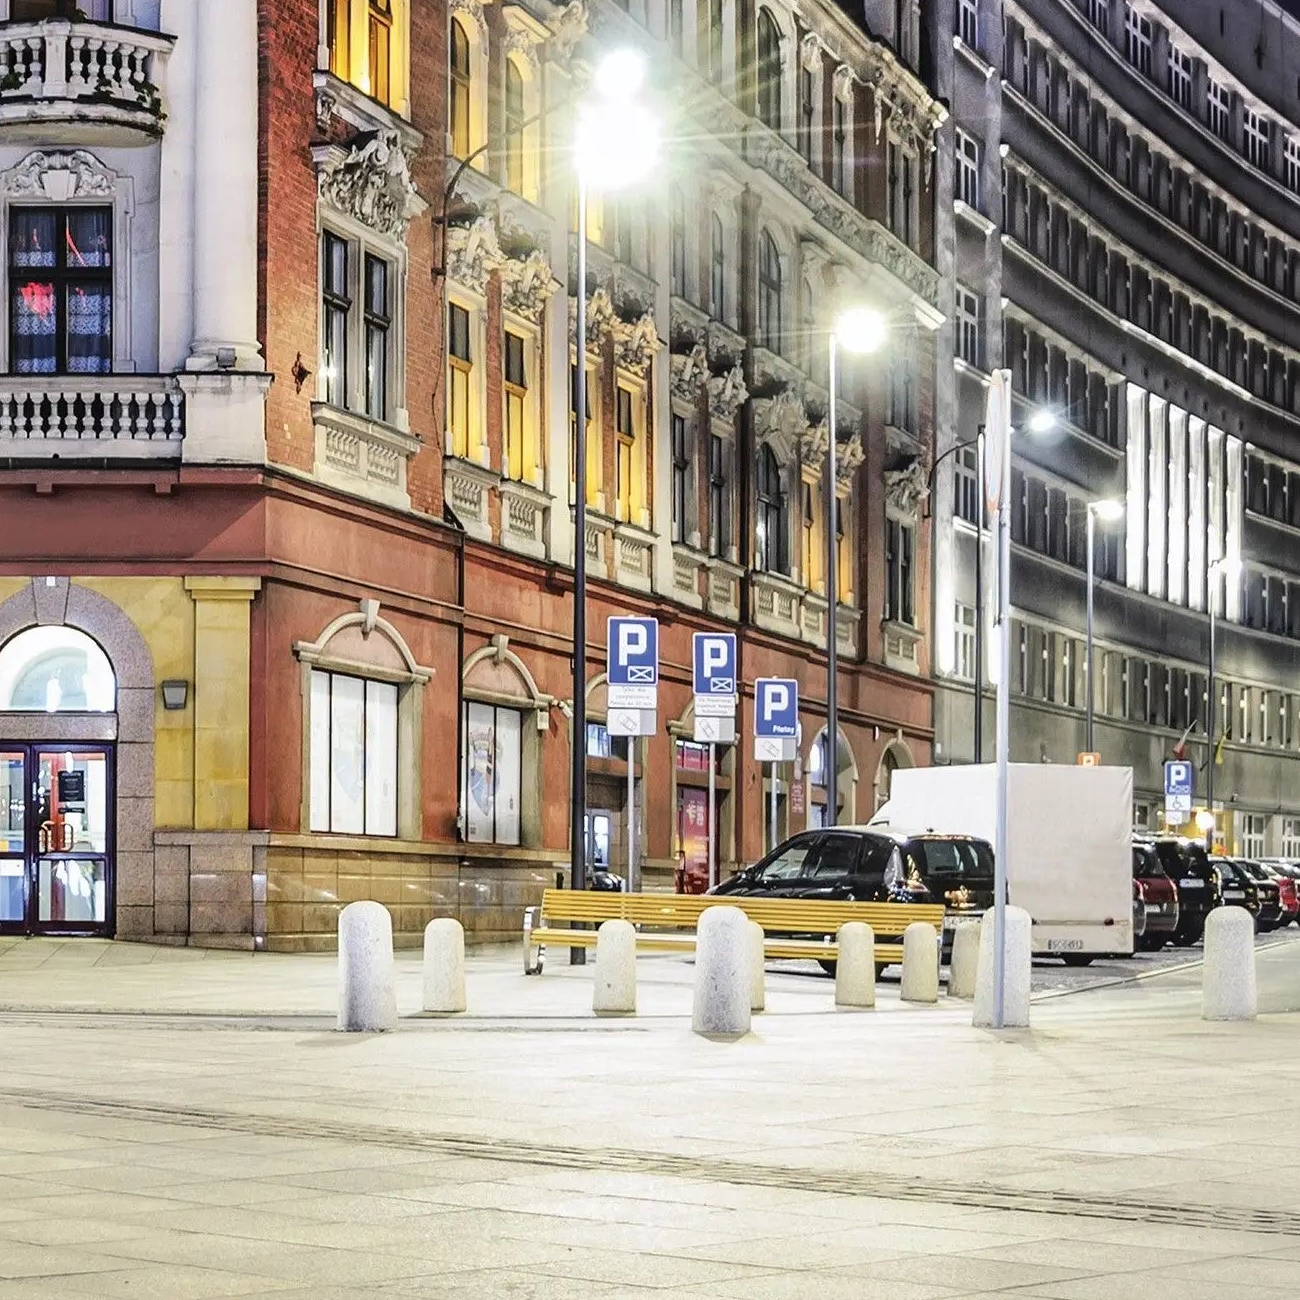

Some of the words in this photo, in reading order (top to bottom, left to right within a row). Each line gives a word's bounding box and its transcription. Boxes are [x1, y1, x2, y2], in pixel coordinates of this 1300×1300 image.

[618, 623, 647, 666] P
[703, 639, 728, 678] P
[764, 684, 788, 720] P
[1171, 764, 1186, 787] P
